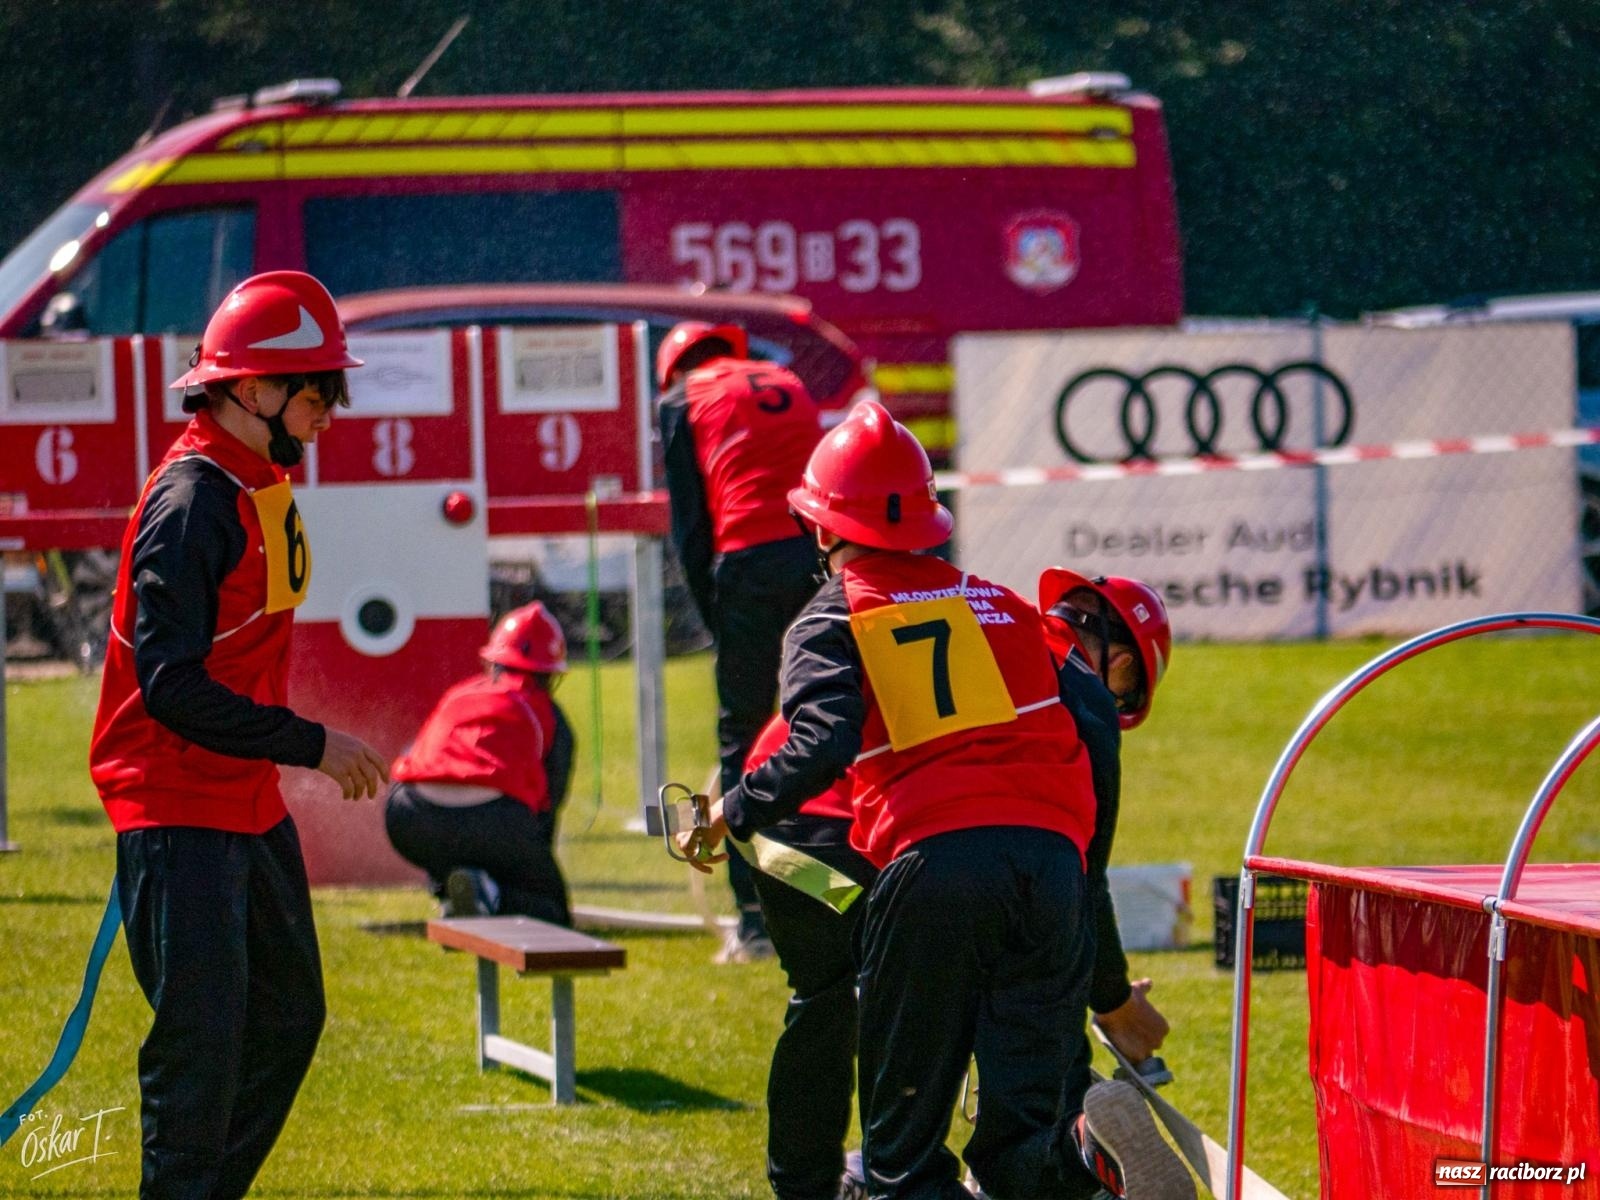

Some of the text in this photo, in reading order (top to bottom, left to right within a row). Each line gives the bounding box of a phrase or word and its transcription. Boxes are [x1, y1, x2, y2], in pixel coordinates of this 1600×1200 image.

[747, 373, 791, 413] 5
[35, 425, 78, 485] 6
[372, 417, 416, 476] 8
[537, 413, 582, 472] 9
[284, 498, 306, 593] 6
[1065, 515, 1323, 557] Dealer Aud
[1156, 559, 1481, 612] sche Rybnik
[891, 618, 957, 719] 7
